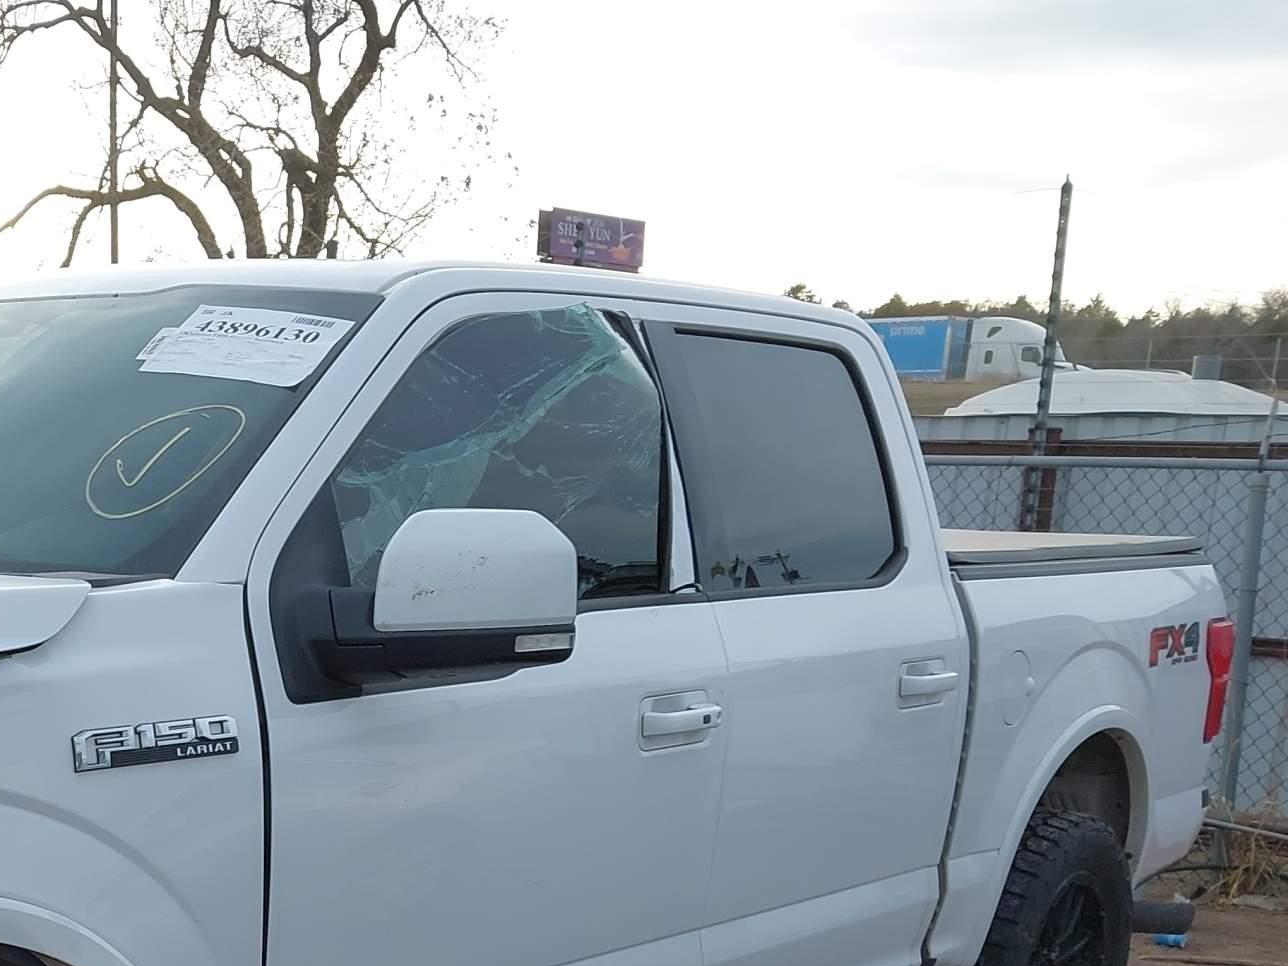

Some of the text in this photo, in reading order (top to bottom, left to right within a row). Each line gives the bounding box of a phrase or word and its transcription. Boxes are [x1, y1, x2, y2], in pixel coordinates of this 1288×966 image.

[557, 222, 611, 241] SHE YUN
[195, 319, 321, 344] 43896130
[890, 324, 925, 337] prime
[1149, 621, 1200, 668] FX4
[176, 741, 233, 757] LARIAT
